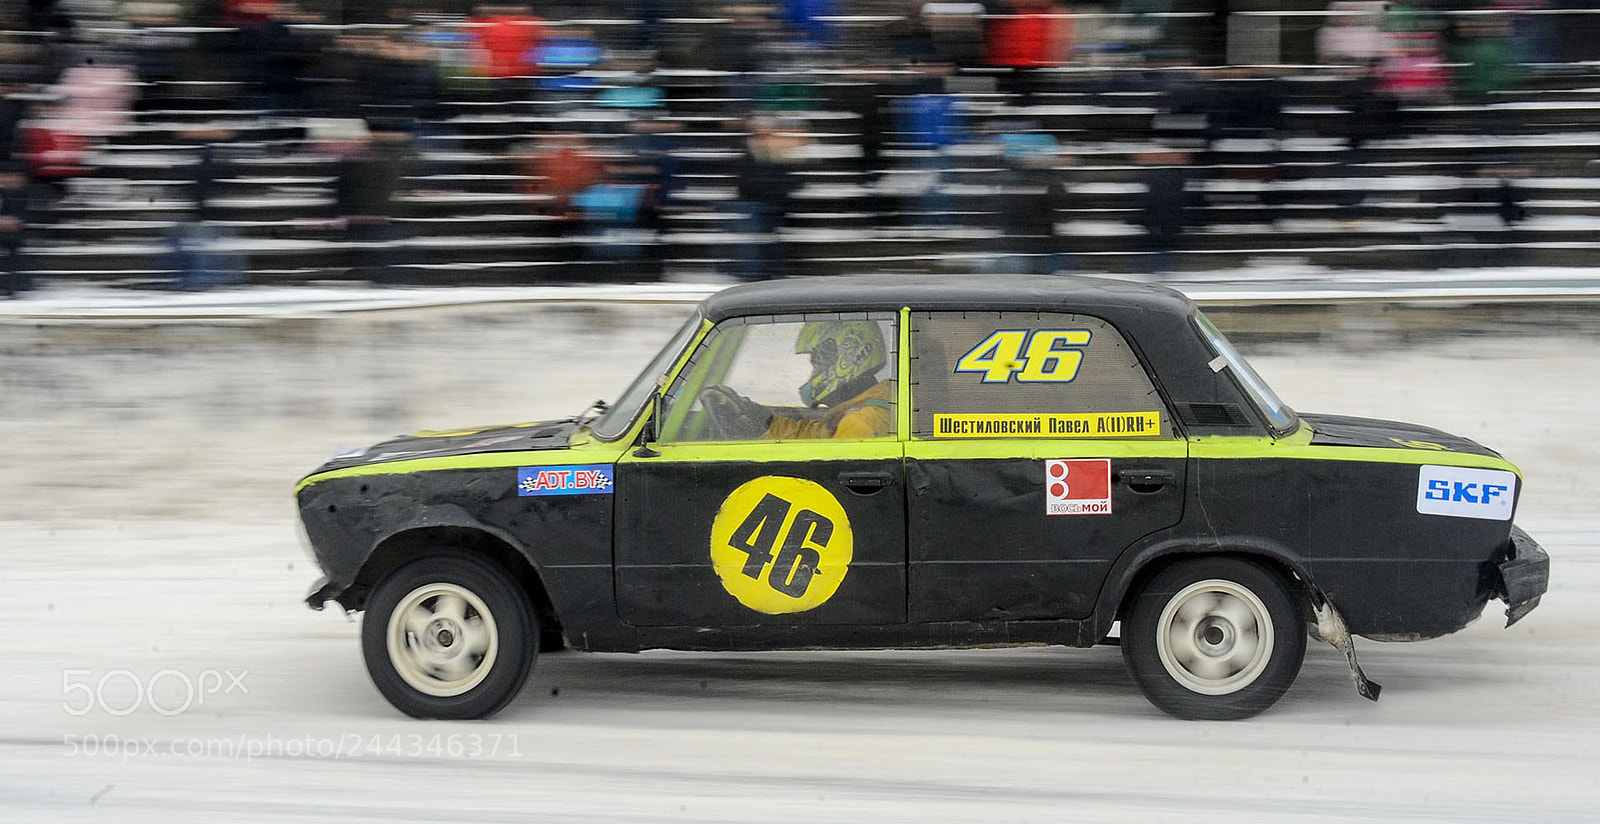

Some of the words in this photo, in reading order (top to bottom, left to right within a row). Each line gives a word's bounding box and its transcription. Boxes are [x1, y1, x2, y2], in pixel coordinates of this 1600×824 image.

[953, 328, 1093, 384] 46
[940, 417, 1041, 434] Шестиловский
[1048, 417, 1090, 433] Павел
[535, 469, 600, 489] ADT.BY
[1425, 479, 1508, 504] SKF
[728, 492, 834, 599] 46
